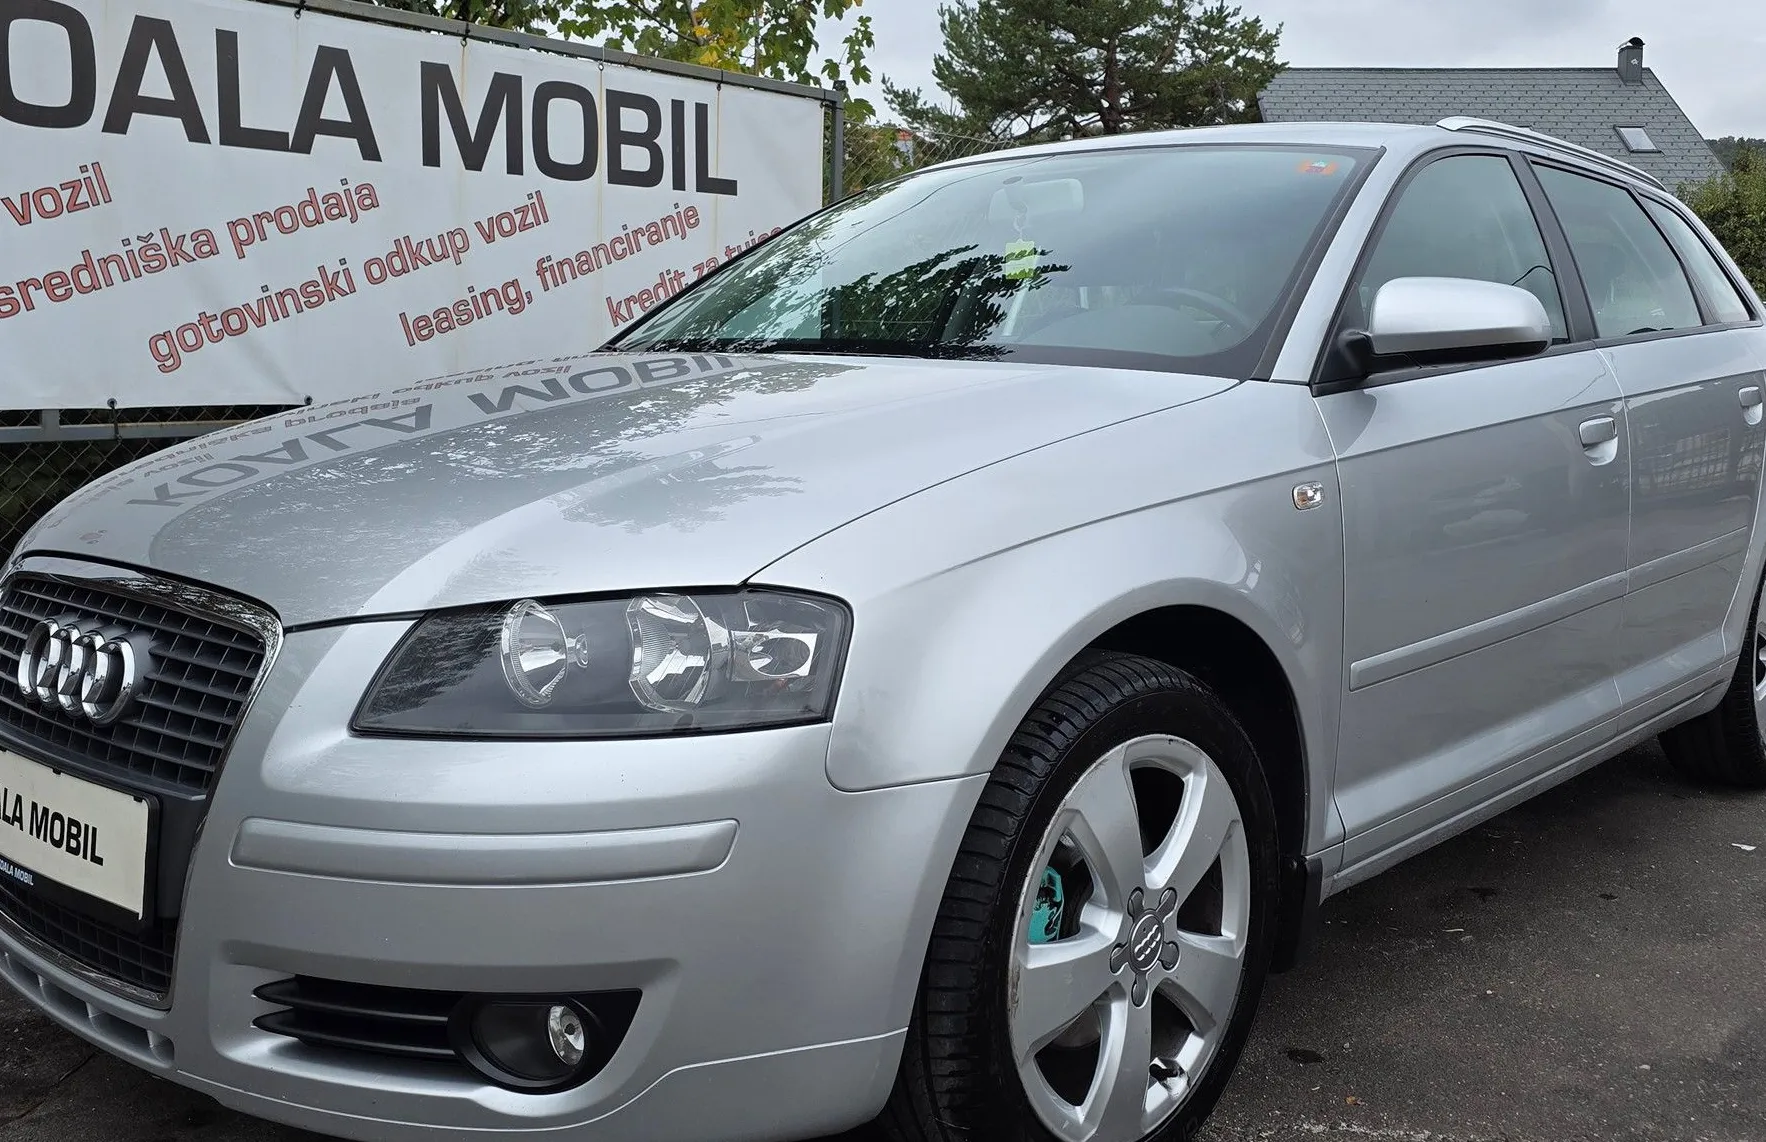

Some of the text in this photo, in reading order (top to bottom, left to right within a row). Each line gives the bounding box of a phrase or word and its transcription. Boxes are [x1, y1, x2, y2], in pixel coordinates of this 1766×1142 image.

[1, 161, 112, 227] vozil
[420, 60, 738, 197] MOBIL
[0, 178, 380, 319] sredniška prodaja
[148, 257, 357, 374] gotovinski
[362, 224, 470, 286] odkup
[474, 190, 550, 245] vozil
[399, 276, 533, 347] leasing,
[535, 203, 700, 292] financiranje
[0, 787, 104, 867] LA MOBIL
